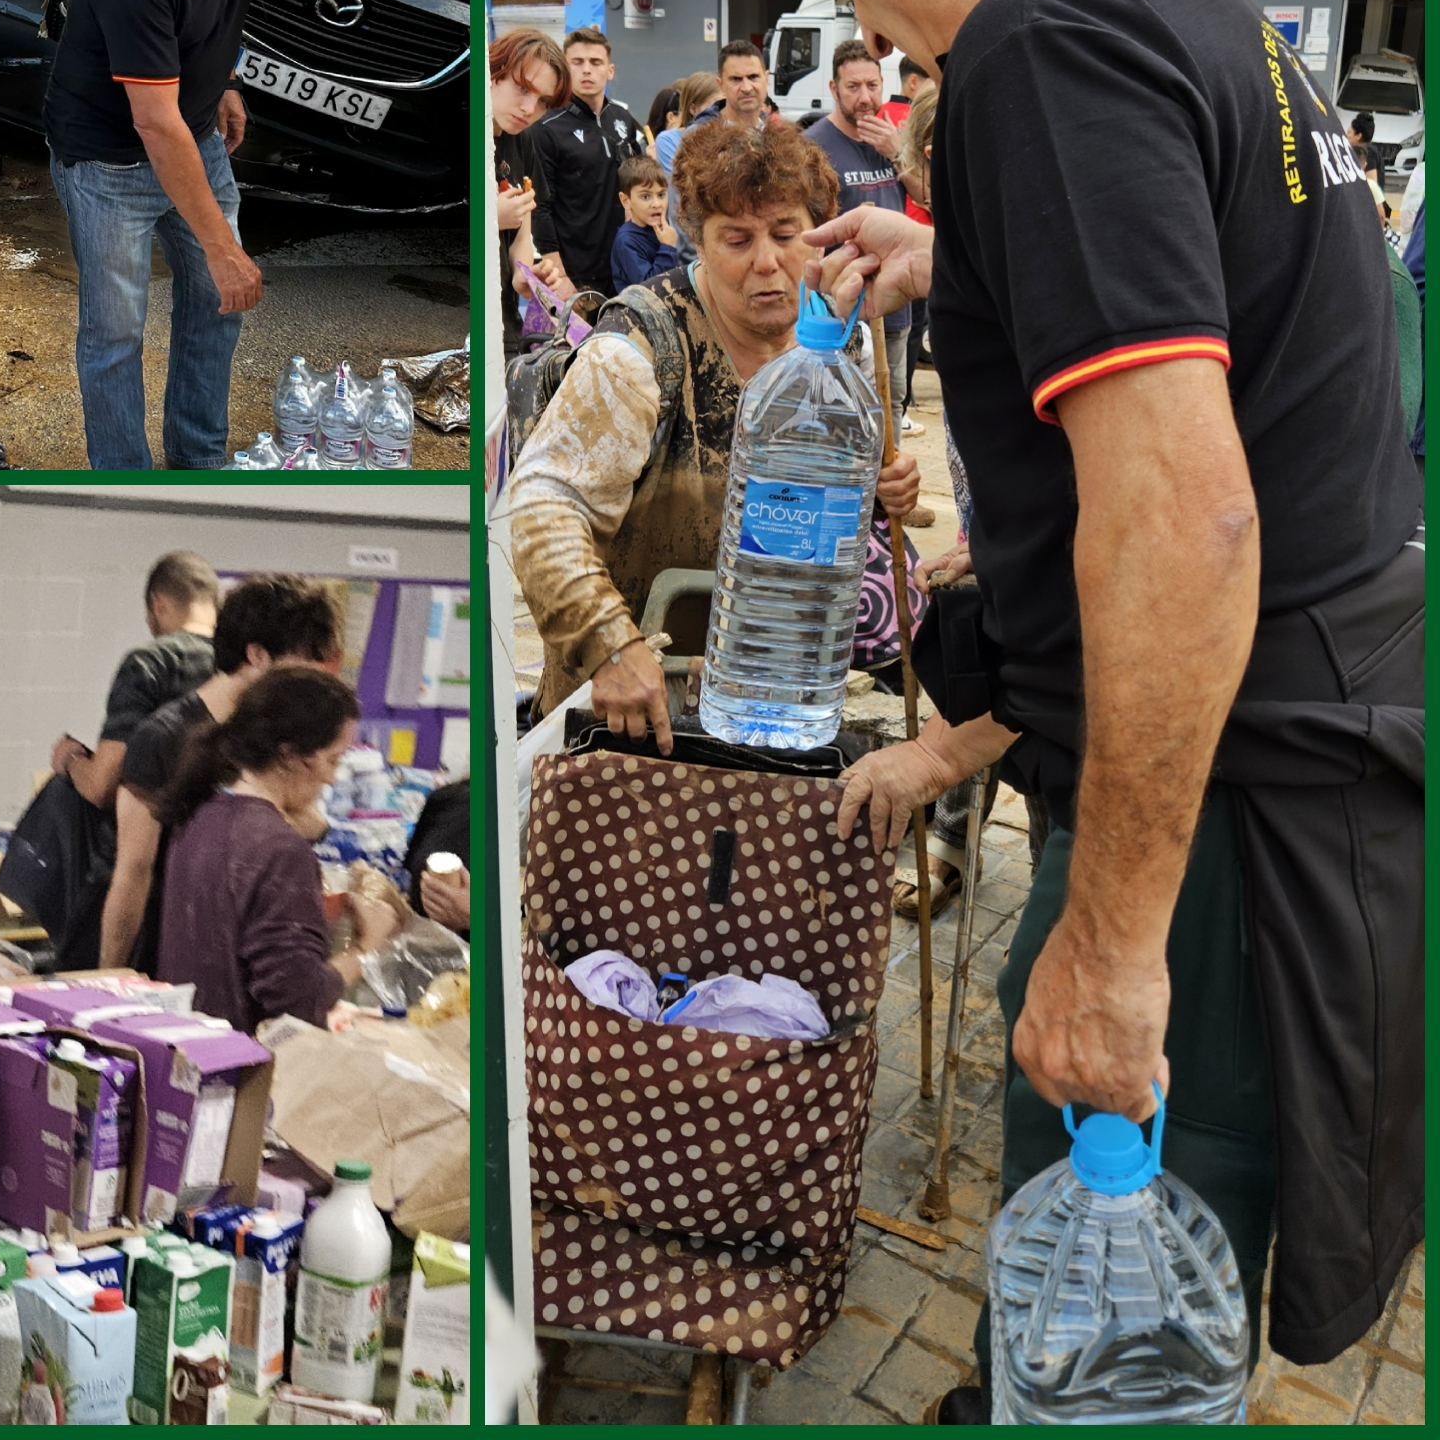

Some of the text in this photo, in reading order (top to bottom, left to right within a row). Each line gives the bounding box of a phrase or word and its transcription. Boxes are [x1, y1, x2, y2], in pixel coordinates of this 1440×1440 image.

[1275, 12, 1298, 20] BOSCH
[242, 54, 376, 124] 5519 KSL
[1267, 58, 1308, 205] RETIRADOS
[844, 167, 895, 183] ST JULIAN
[746, 501, 820, 525] chóvar
